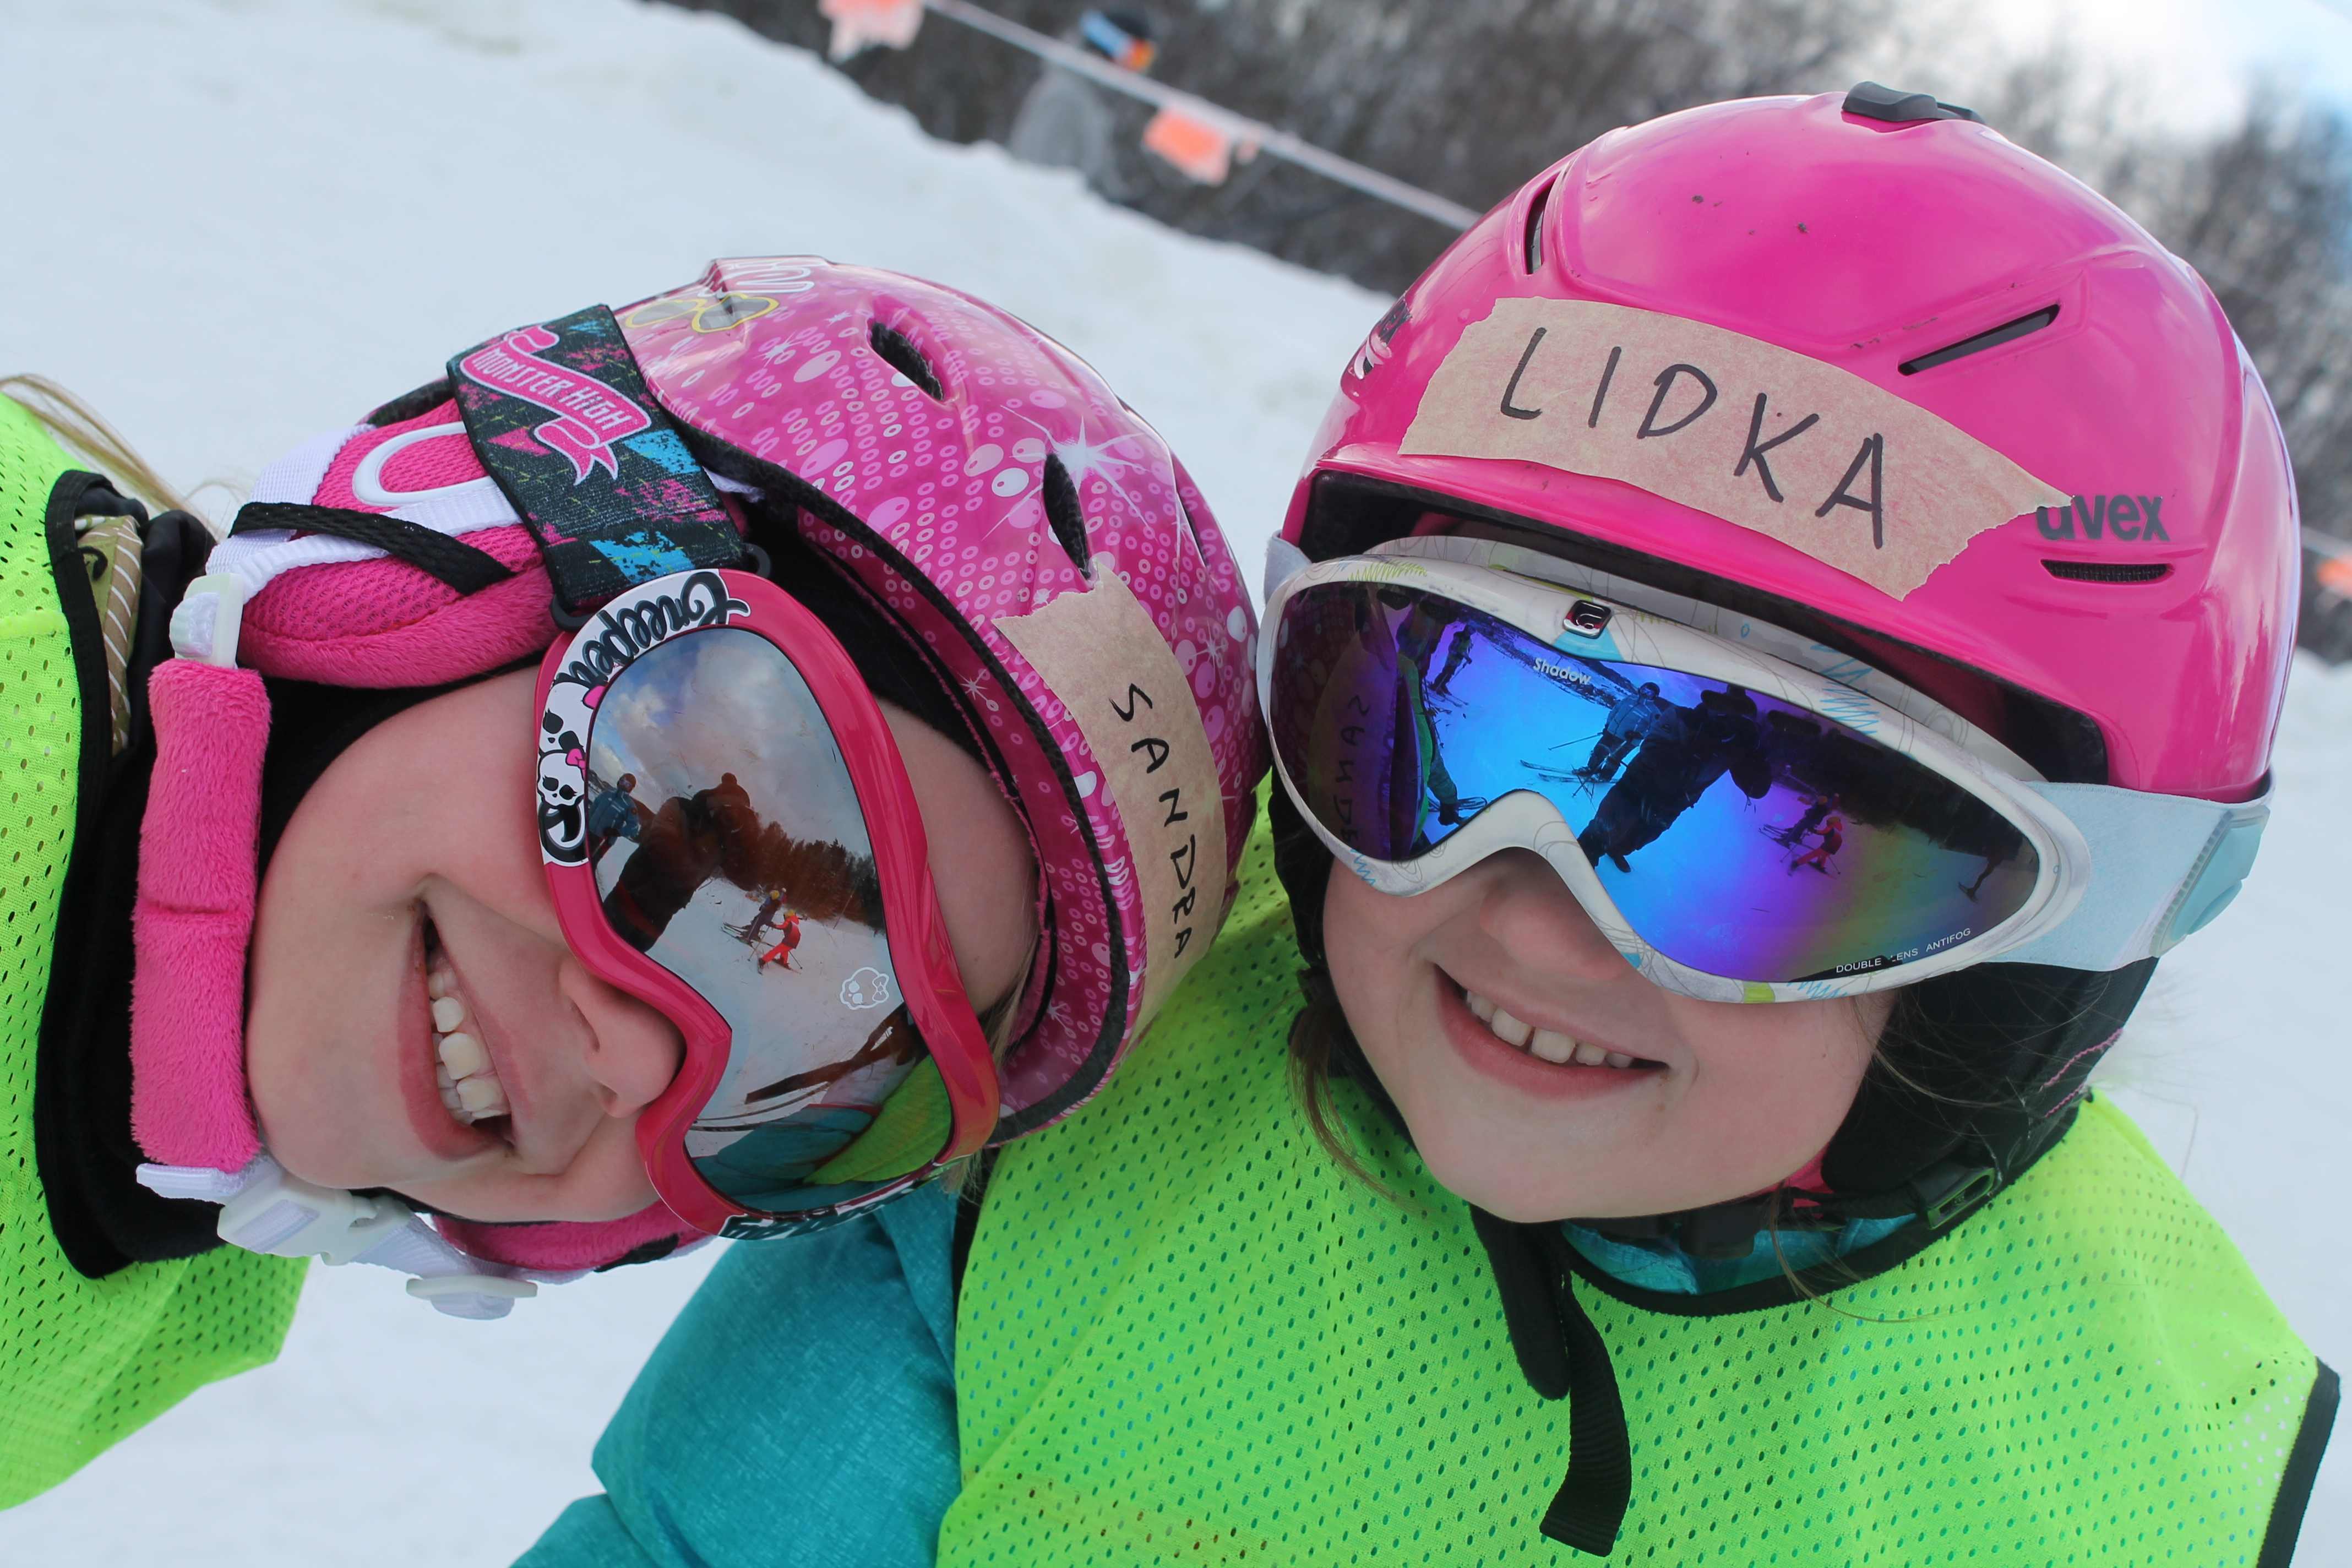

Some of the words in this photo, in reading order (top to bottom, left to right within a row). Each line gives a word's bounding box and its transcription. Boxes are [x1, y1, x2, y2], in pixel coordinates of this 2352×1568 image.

[471, 348, 568, 399] MONSTER
[1499, 326, 1884, 549] LIDKA
[2036, 494, 2170, 541] uvex
[1533, 657, 1592, 684] Shadow
[1109, 683, 1197, 959] SANDRA
[1836, 957, 1882, 973] DOUBLE
[1925, 928, 1972, 952] ANTIFOG
